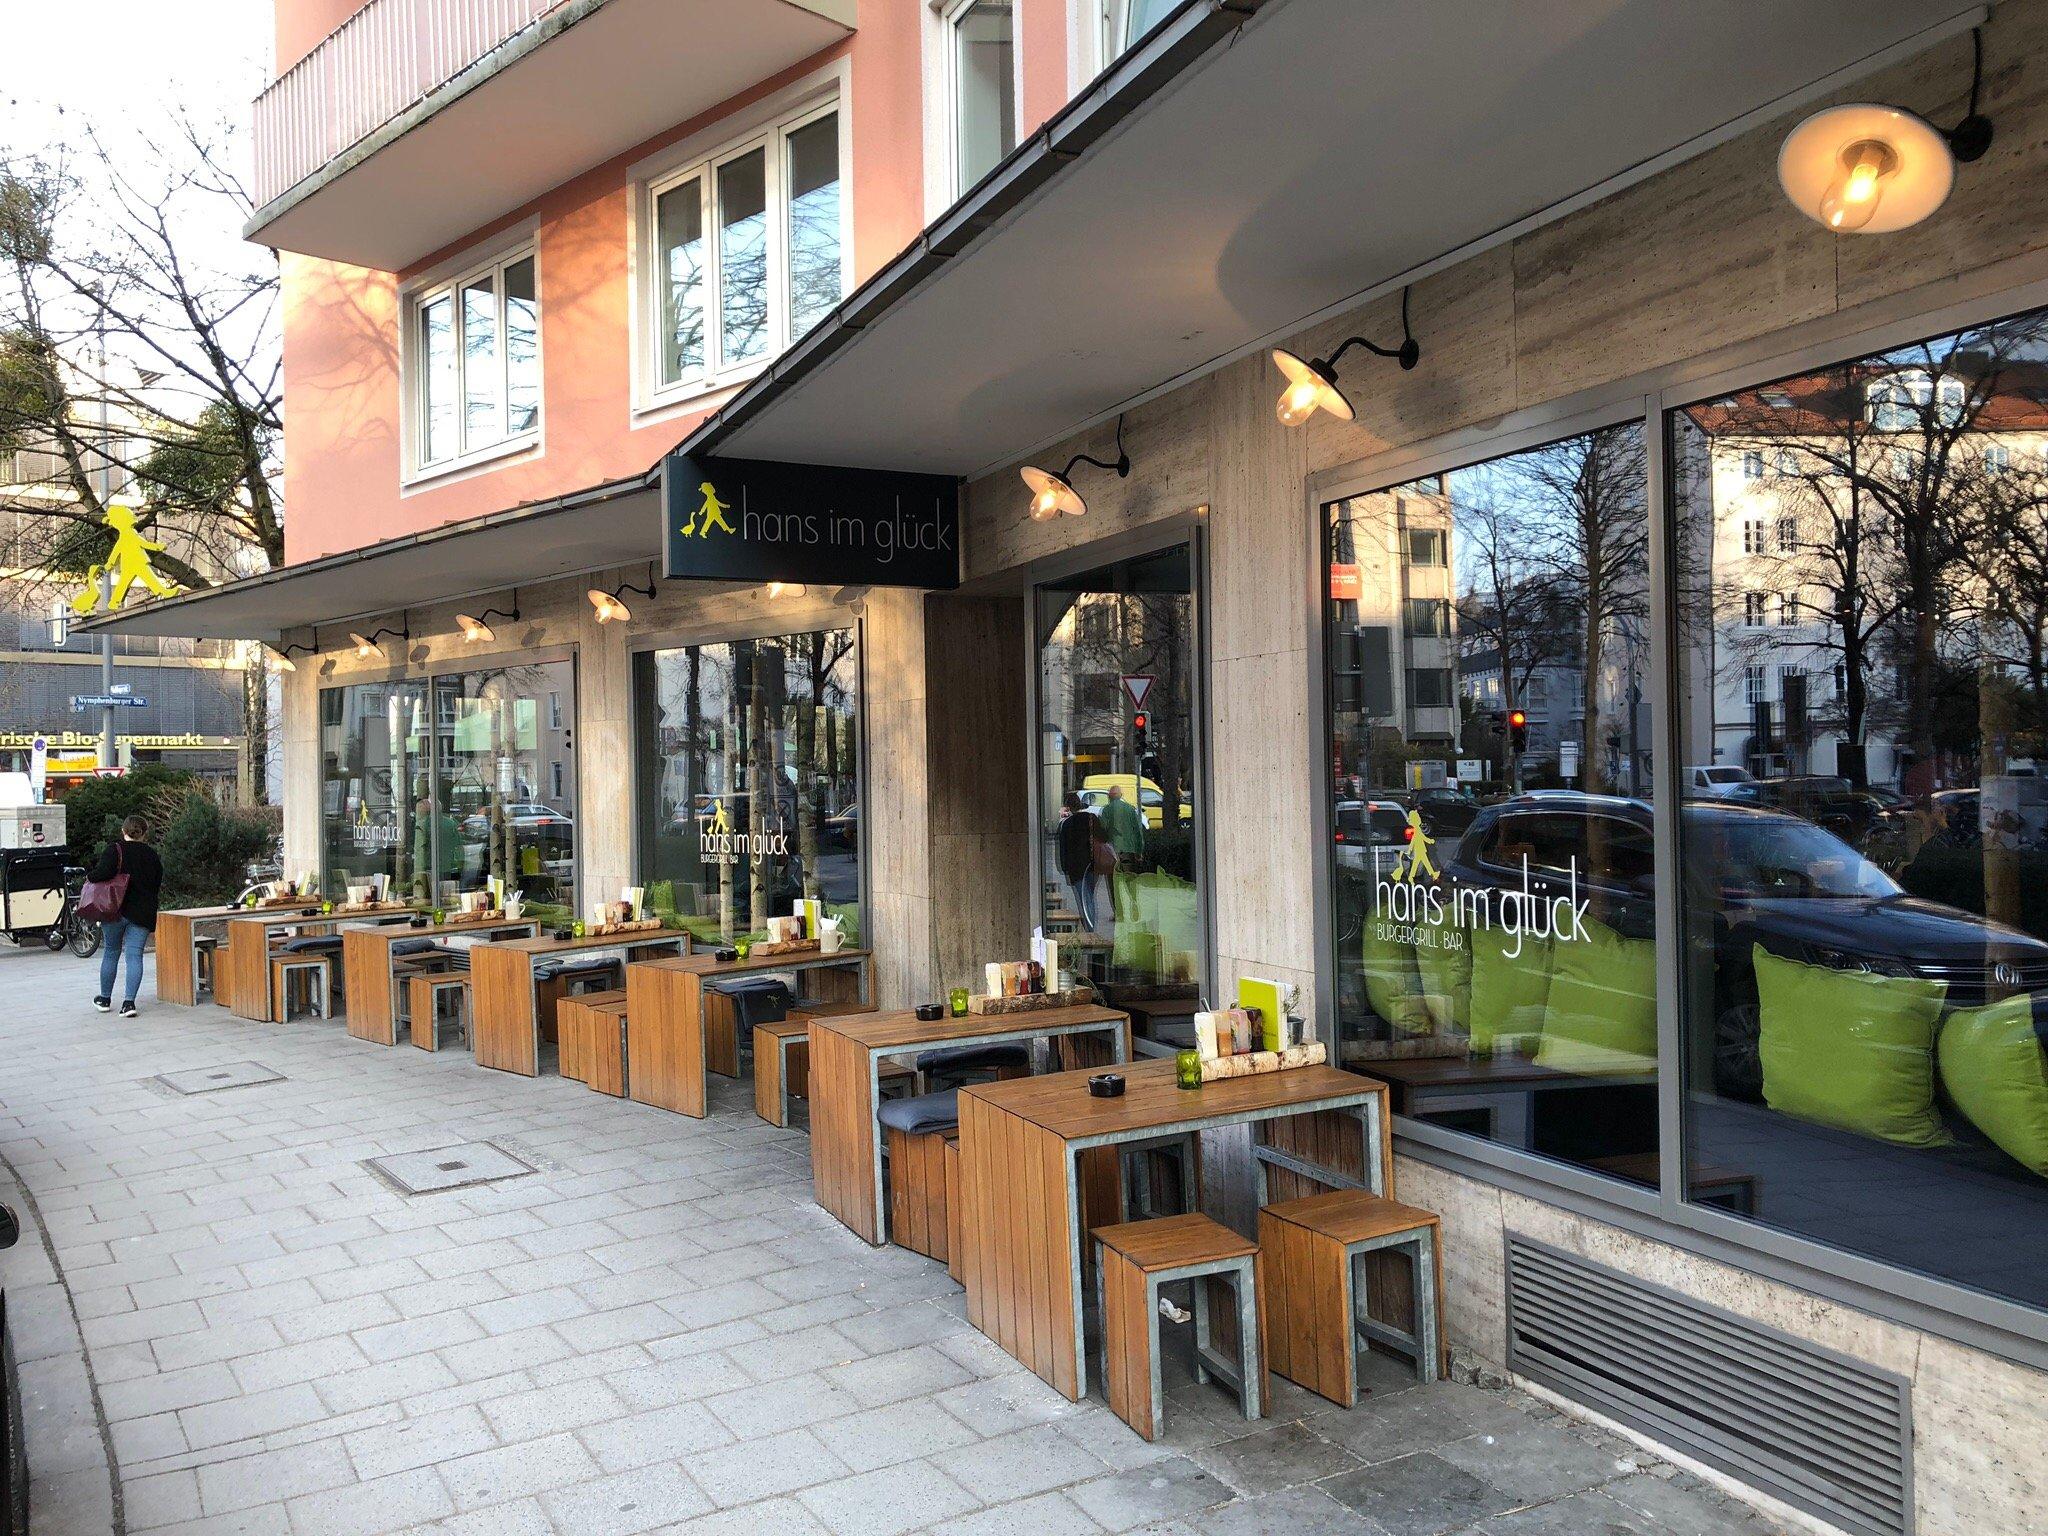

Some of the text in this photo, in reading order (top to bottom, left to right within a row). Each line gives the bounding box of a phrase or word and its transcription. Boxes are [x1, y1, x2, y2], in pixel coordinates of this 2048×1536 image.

[742, 484, 951, 563] hans im glück
[78, 696, 146, 706] Nymphenburger Str.
[0, 731, 203, 745] risce Bio-permarkt
[353, 811, 402, 849] hans im glück
[700, 816, 788, 865] hans im glück
[1374, 845, 1592, 959] hans im glück
[1377, 922, 1463, 951] BURGERGRILL BAR
